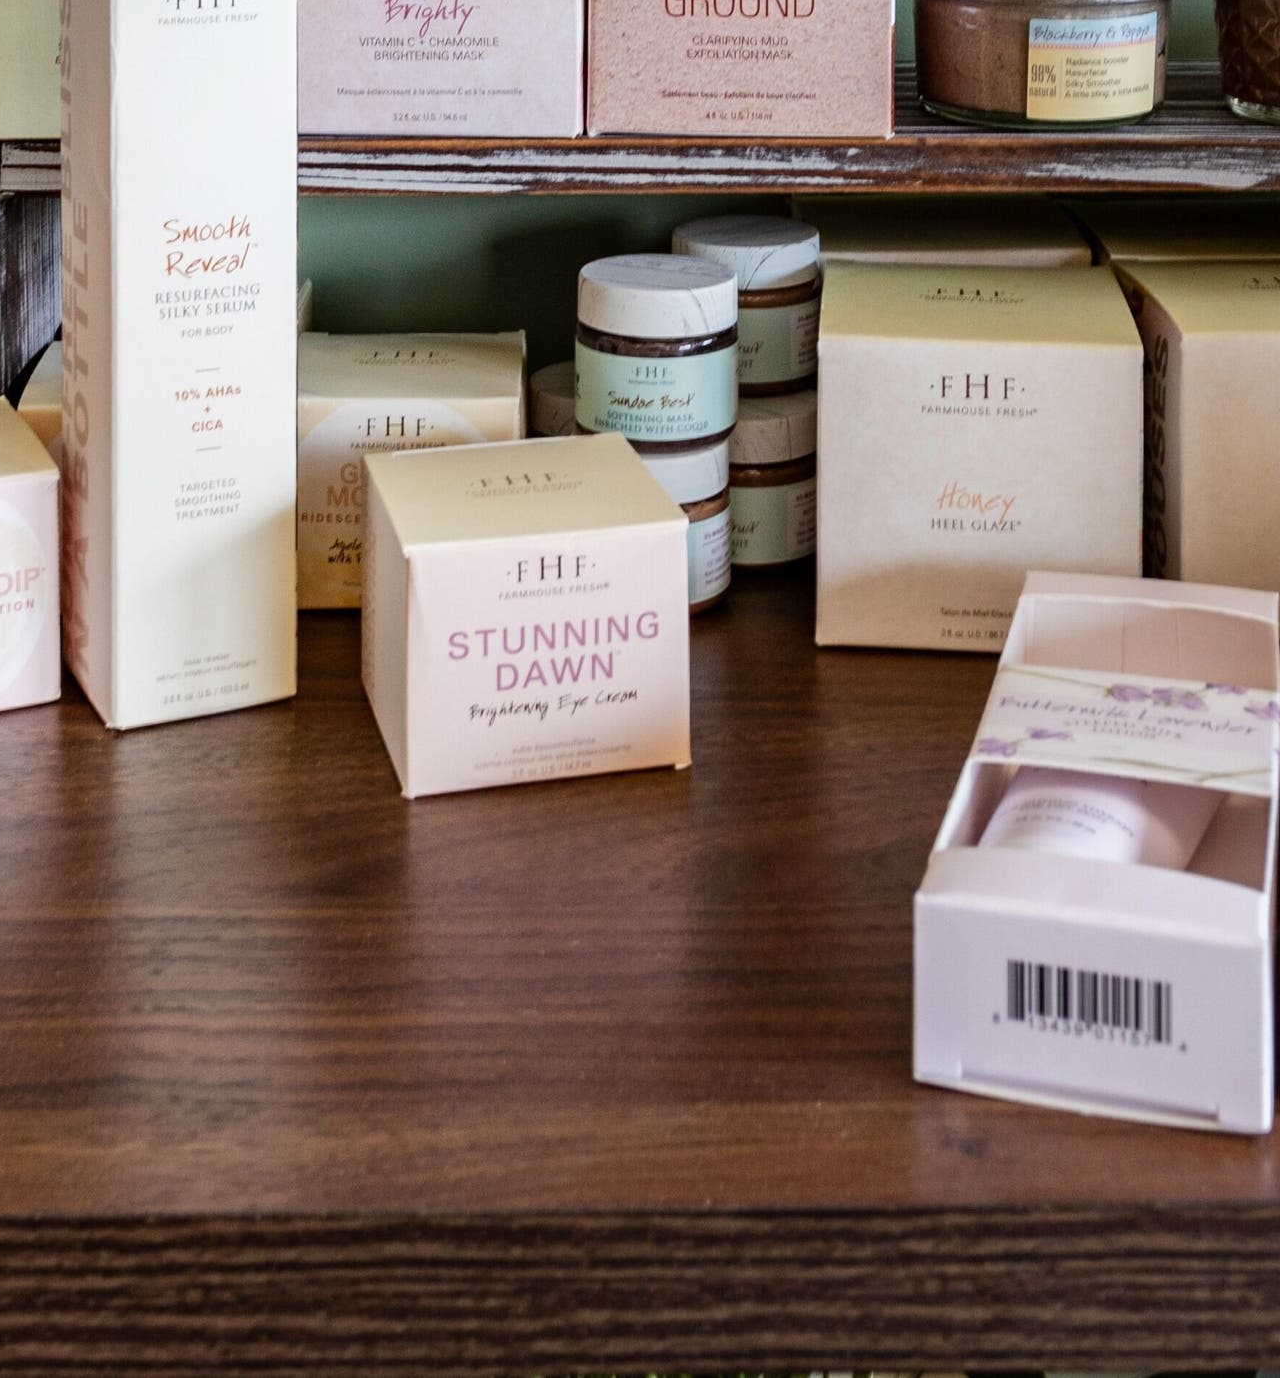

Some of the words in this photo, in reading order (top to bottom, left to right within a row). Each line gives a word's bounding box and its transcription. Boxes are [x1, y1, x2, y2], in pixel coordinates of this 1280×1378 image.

[158, 15, 221, 26] FARMHOUSE
[359, 36, 405, 48] VITAMIN
[408, 36, 416, 48] C
[429, 36, 500, 48] CHAMOMILE
[692, 35, 758, 46] CLARIFYING
[761, 36, 788, 46] MUD
[1033, 25, 1103, 47] Blackberry
[374, 50, 450, 62] BRIGHTENING
[453, 50, 484, 61] MASK
[686, 49, 759, 60] EXFOLIATION
[762, 50, 794, 60] MASK
[1031, 64, 1056, 84] 98%
[1029, 86, 1057, 97] natural
[163, 215, 251, 244] Smooth
[155, 283, 261, 305] RESURFACING
[159, 303, 203, 320] SILKY
[206, 300, 256, 315] SERUM
[181, 327, 203, 338] FOR
[205, 325, 234, 336] BODY
[73, 196, 89, 504] BOTTLE
[175, 389, 201, 402] 10%
[206, 385, 241, 397] AHAs
[608, 390, 655, 409] Sundae
[660, 393, 695, 410] Best
[607, 410, 663, 423] SOFTENING
[667, 413, 694, 422] MASK
[921, 404, 992, 418] FARMHOUSE
[191, 419, 224, 433] CICA
[646, 425, 674, 434] WITH
[350, 442, 406, 450] FARMHOUSE
[1152, 334, 1169, 571] OUSES
[180, 478, 236, 493] TARGETED
[174, 490, 242, 508] SMOOTHING
[936, 481, 1016, 525] Honey
[176, 504, 240, 521] TREATMENT
[300, 513, 361, 523] RIDESCE
[931, 518, 966, 532] HEEL
[498, 587, 565, 601] FARMHOUSE
[447, 611, 661, 661] STUNNING
[496, 651, 615, 692] DAWN
[469, 700, 550, 727] Brightening
[557, 694, 590, 717] Eye
[595, 688, 638, 706] Cream
